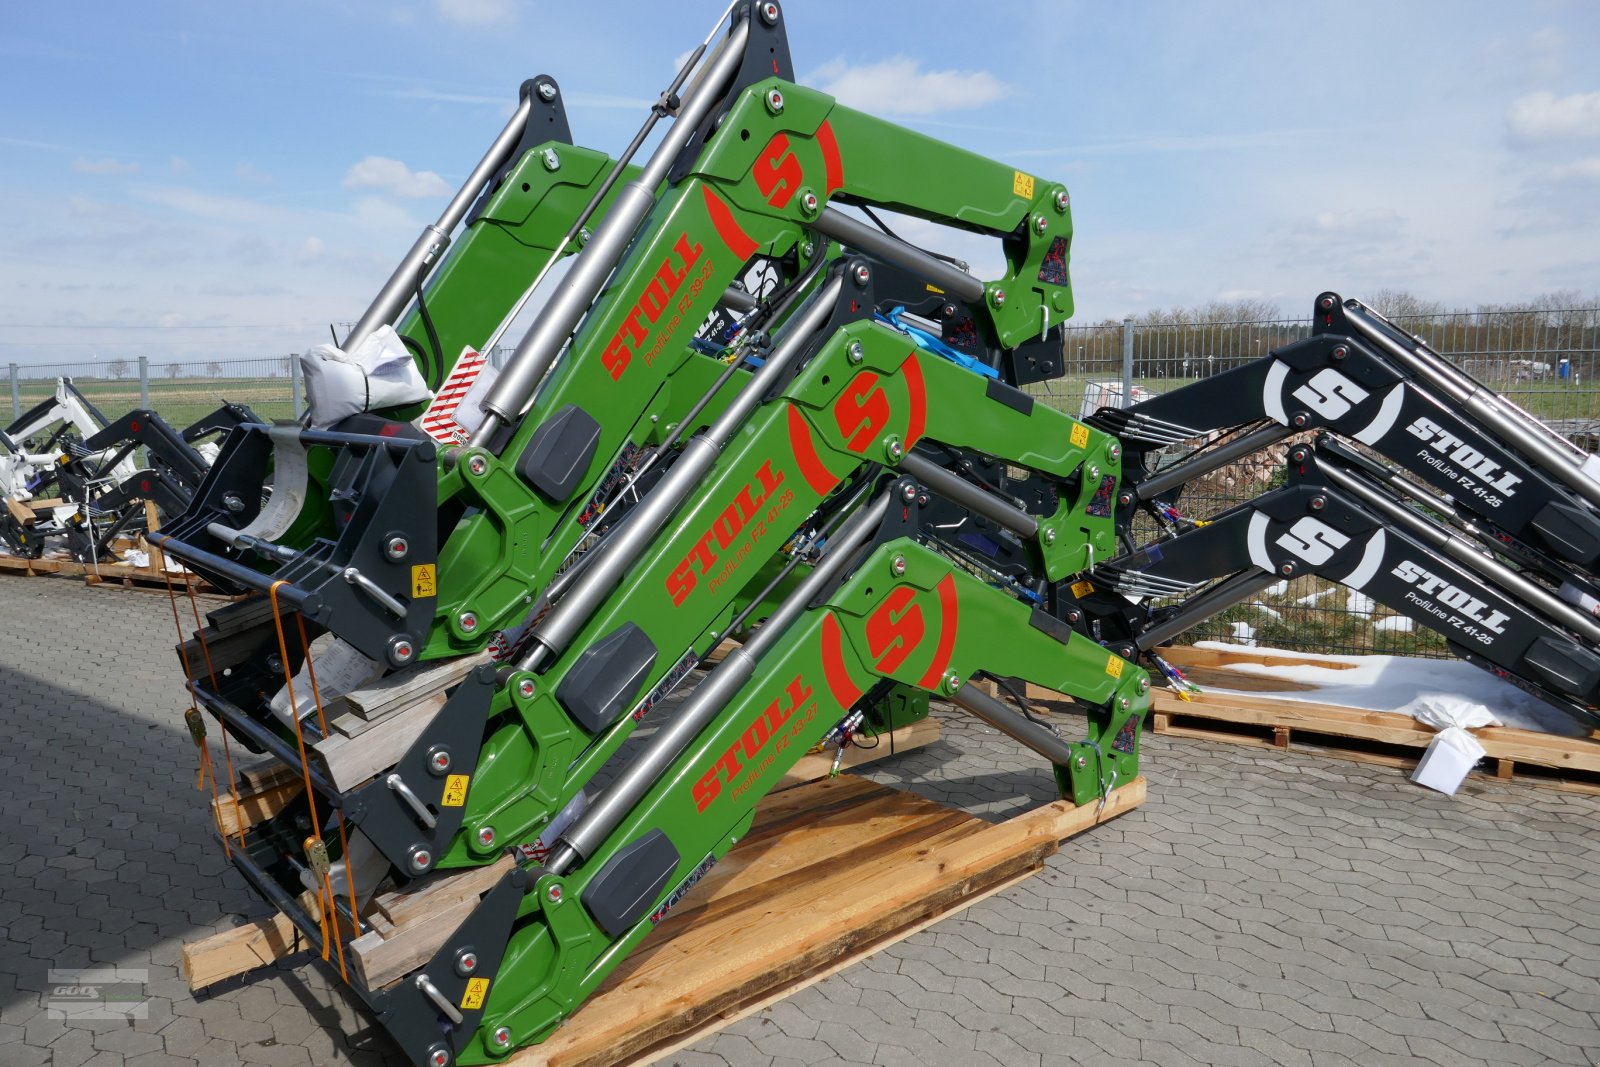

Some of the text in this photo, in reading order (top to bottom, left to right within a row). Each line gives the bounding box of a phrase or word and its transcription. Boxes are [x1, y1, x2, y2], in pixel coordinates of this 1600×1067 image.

[601, 233, 703, 382] STOLL
[643, 260, 714, 367] ProfiLine FZ 39-27
[1405, 416, 1523, 498] STOLL
[1416, 449, 1504, 508] ProfiLine FZ 41-25
[665, 458, 785, 608] STOLL
[708, 488, 795, 596] ProfiLine FZ 41-25
[1391, 560, 1510, 635] STOLL
[1404, 590, 1495, 646] ProfiLine FZ 41-25
[691, 674, 813, 814] STOLL
[731, 702, 818, 802] ProfiLine FZ 43-27
